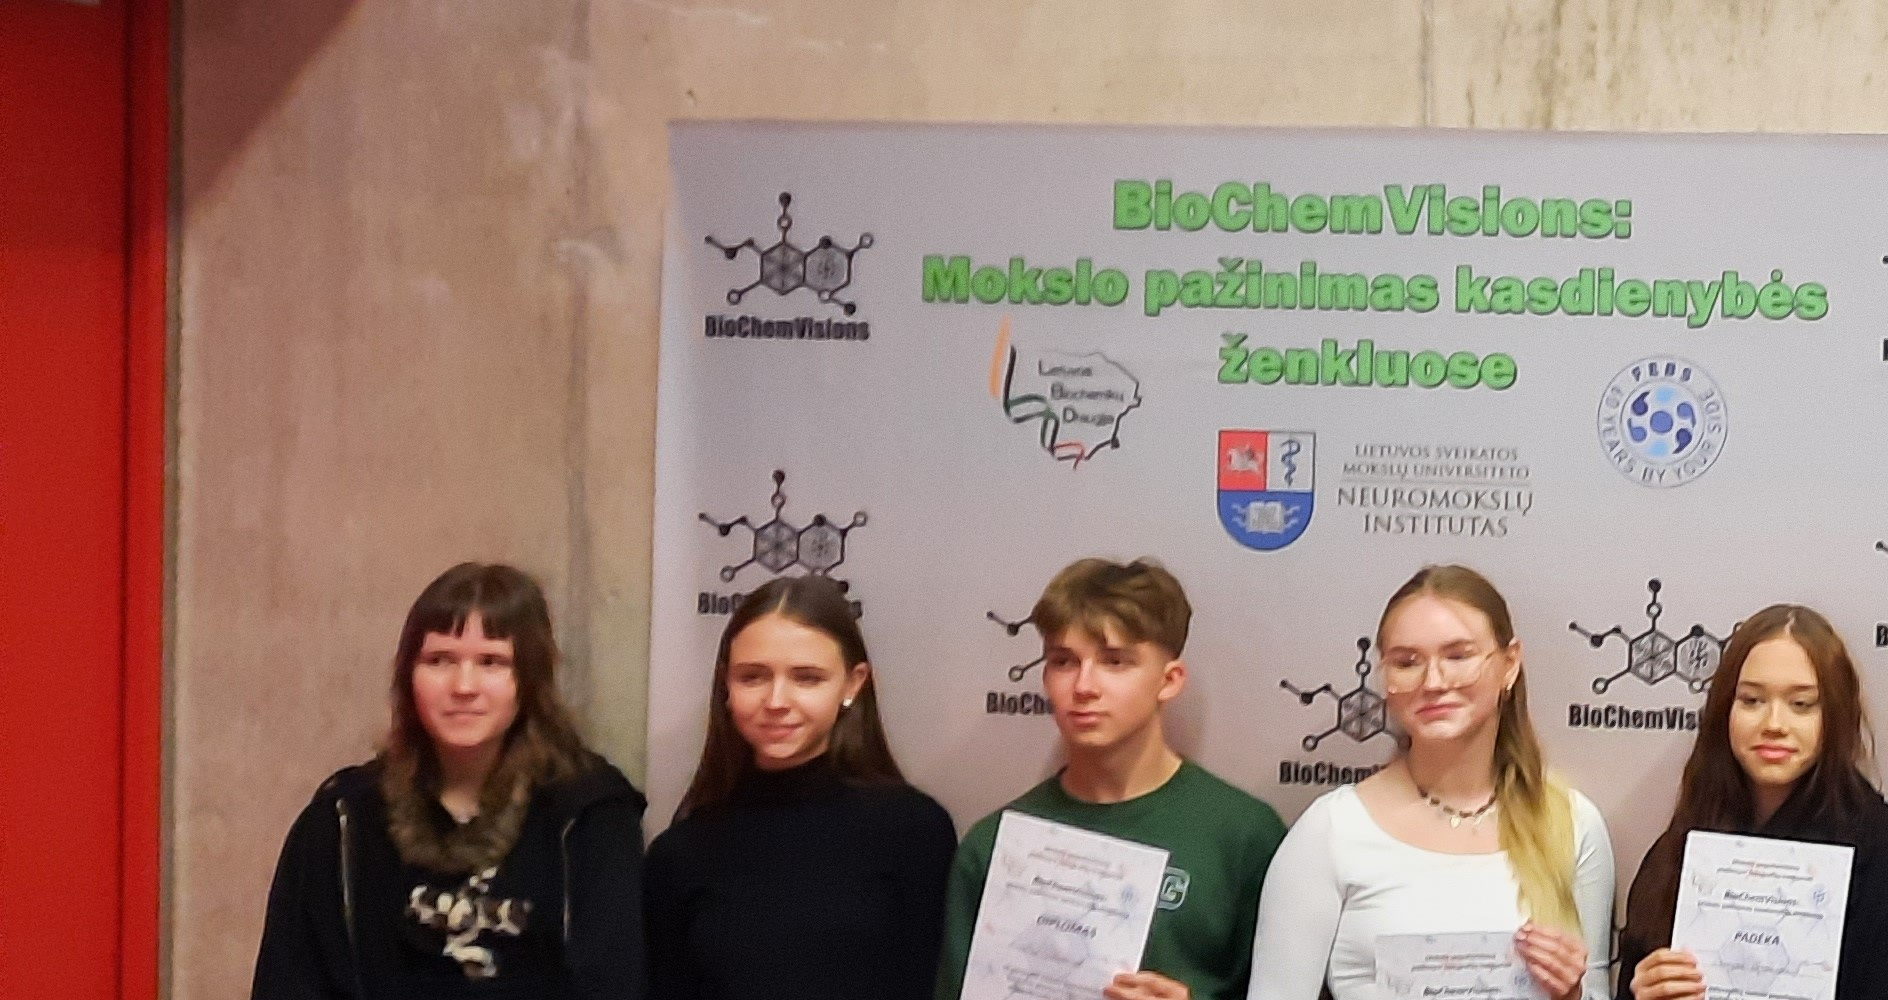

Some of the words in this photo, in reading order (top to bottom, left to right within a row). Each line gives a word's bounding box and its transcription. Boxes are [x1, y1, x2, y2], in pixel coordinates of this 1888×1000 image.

[1113, 179, 1633, 239] BioChemVisions:
[923, 255, 1131, 306] Mokslo
[1144, 257, 1441, 316] pažinimas
[1454, 265, 1830, 328] kasdienybės
[705, 315, 870, 341] BioChemVisions
[1217, 333, 1519, 390] ženkluose
[1355, 443, 1430, 459] LIETUVOS
[1337, 486, 1534, 517] NEUROMOKSLŲ
[1364, 512, 1508, 537] INSTITUTAS
[1568, 703, 1697, 731] BioChemVis
